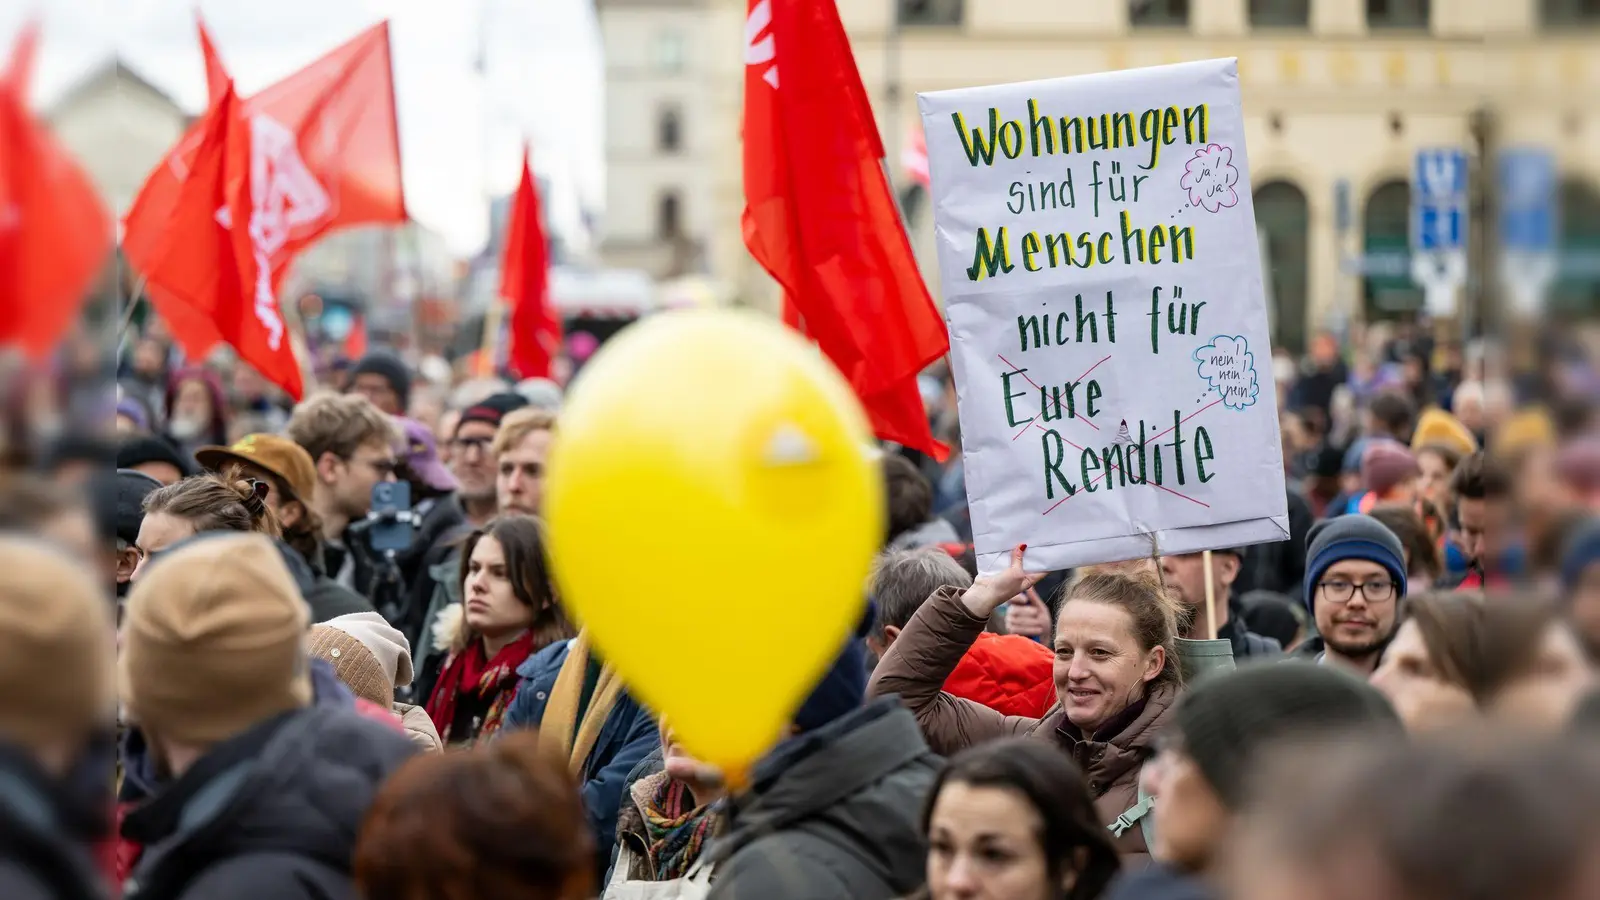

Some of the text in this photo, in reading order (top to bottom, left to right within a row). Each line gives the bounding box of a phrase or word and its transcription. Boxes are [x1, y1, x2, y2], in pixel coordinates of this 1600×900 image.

[951, 98, 1209, 170] Wohnungen
[1006, 160, 1150, 217] sind für
[1195, 156, 1221, 183] ja!
[1206, 173, 1229, 198] ja!
[966, 210, 1195, 281] Menschen
[1017, 285, 1207, 354] nicht für
[1210, 343, 1240, 367] nein!
[1219, 359, 1247, 380] nein!
[1000, 368, 1103, 428] Eure
[1041, 409, 1216, 500] Rendite
